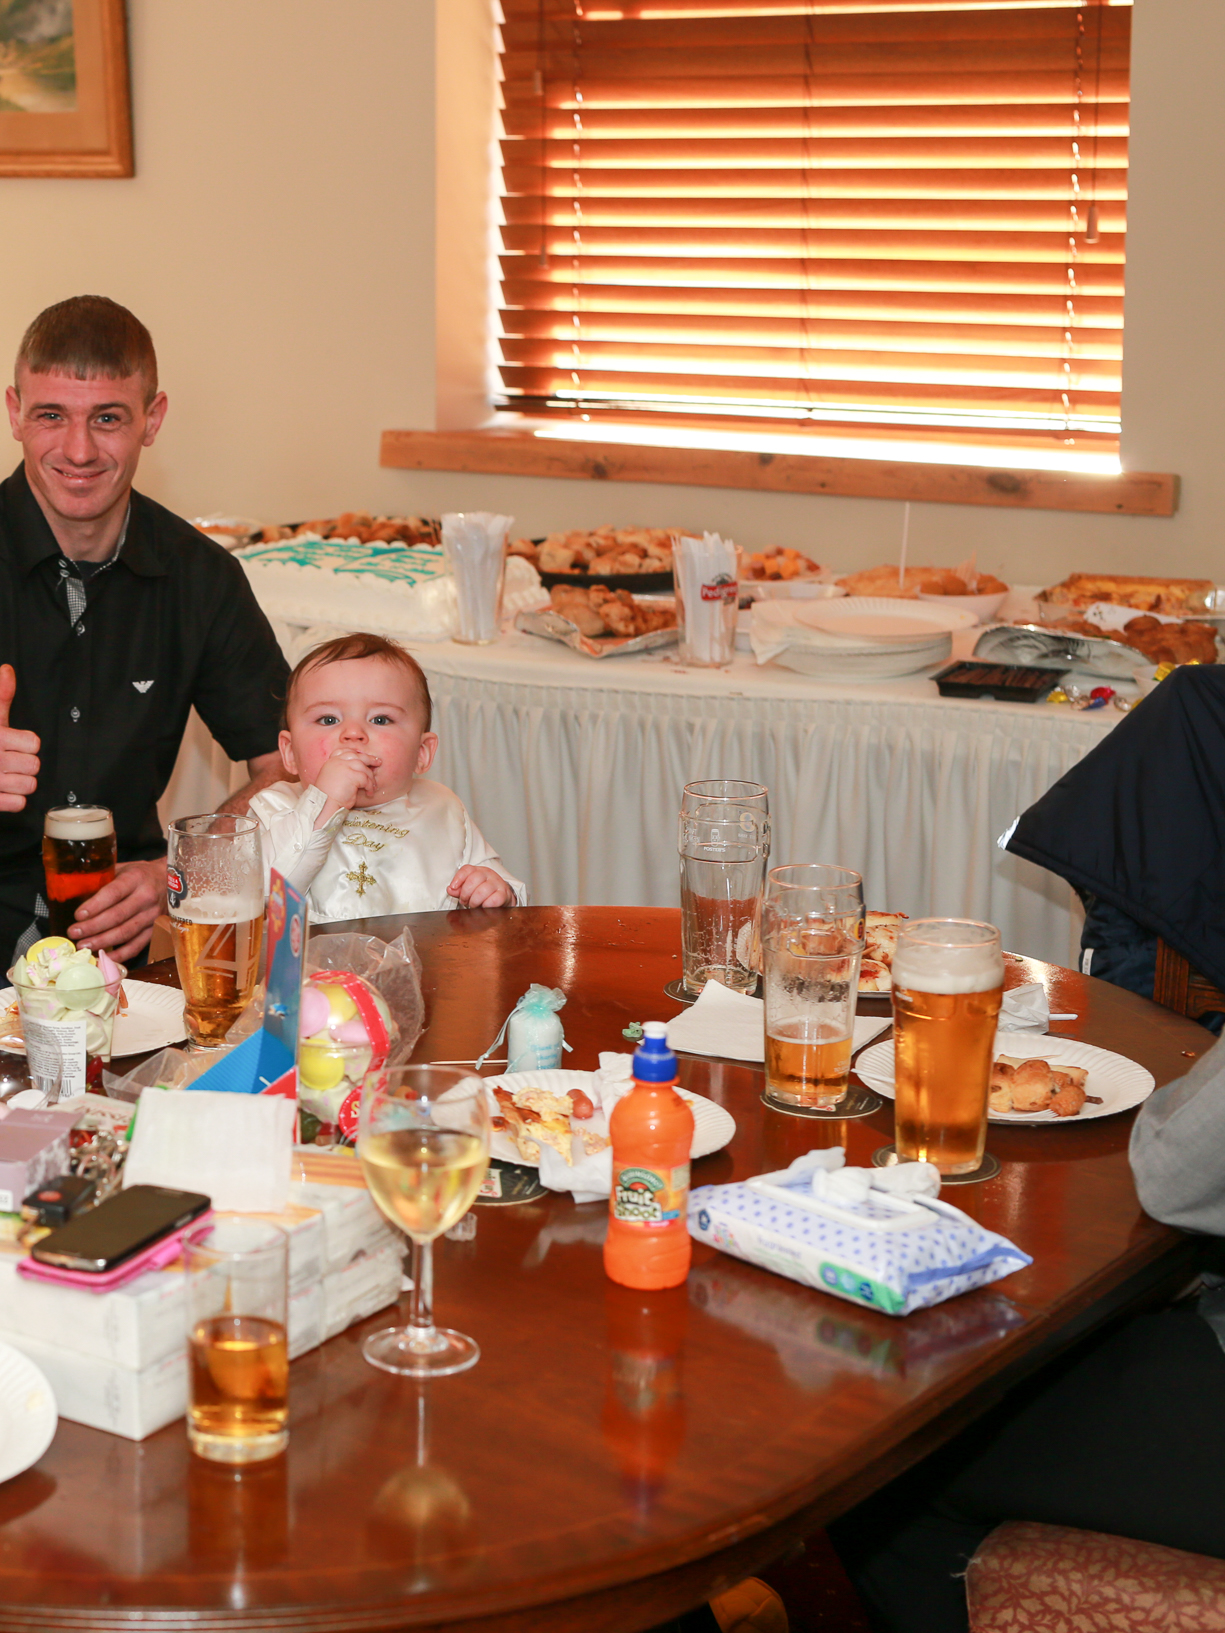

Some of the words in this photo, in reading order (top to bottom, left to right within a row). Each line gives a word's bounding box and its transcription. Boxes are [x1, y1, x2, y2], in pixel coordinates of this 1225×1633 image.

[342, 816, 410, 838] ristening
[342, 833, 385, 852] Day
[615, 1186, 654, 1206] Fruit
